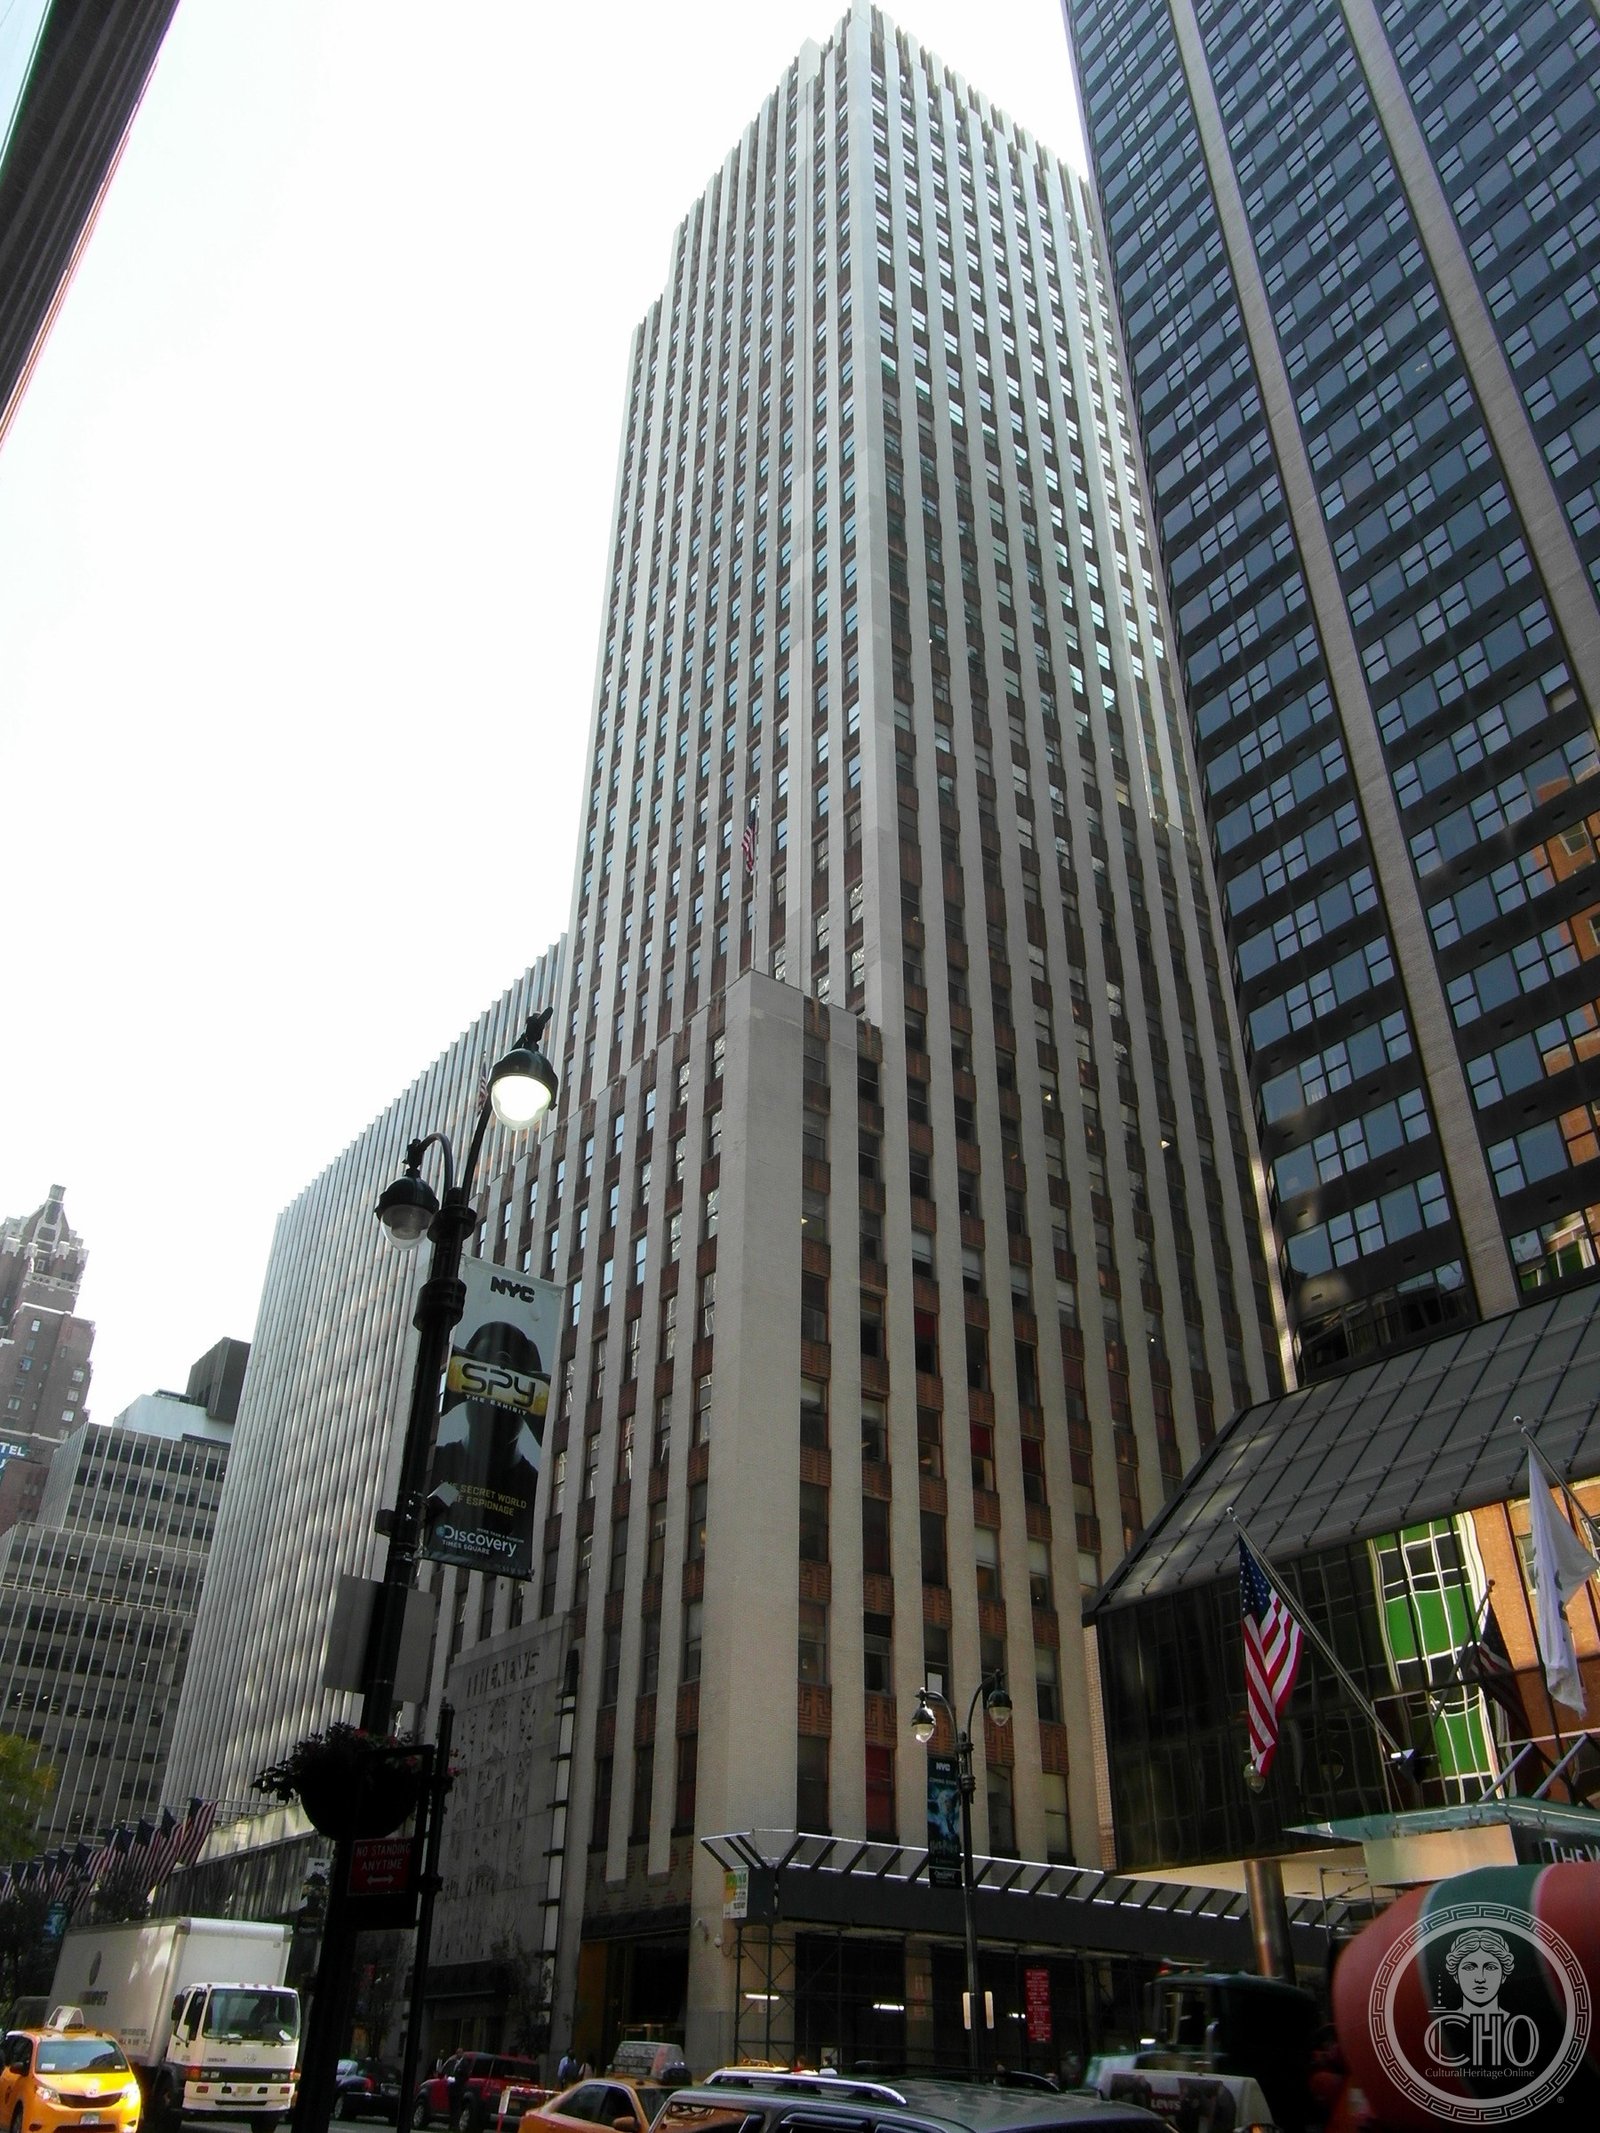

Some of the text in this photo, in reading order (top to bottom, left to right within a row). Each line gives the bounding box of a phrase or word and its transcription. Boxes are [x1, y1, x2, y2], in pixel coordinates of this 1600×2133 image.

[490, 1276, 535, 1303] NYC
[461, 1362, 536, 1407] SPY
[465, 1395, 528, 1416] THE EXHIBIT
[459, 1484, 496, 1499] SECRET
[498, 1493, 527, 1509] WORLD
[466, 1496, 515, 1516] ESPIONAGE
[442, 1540, 490, 1555] TIMES SQUARE
[356, 1842, 411, 1857] NO STANDING
